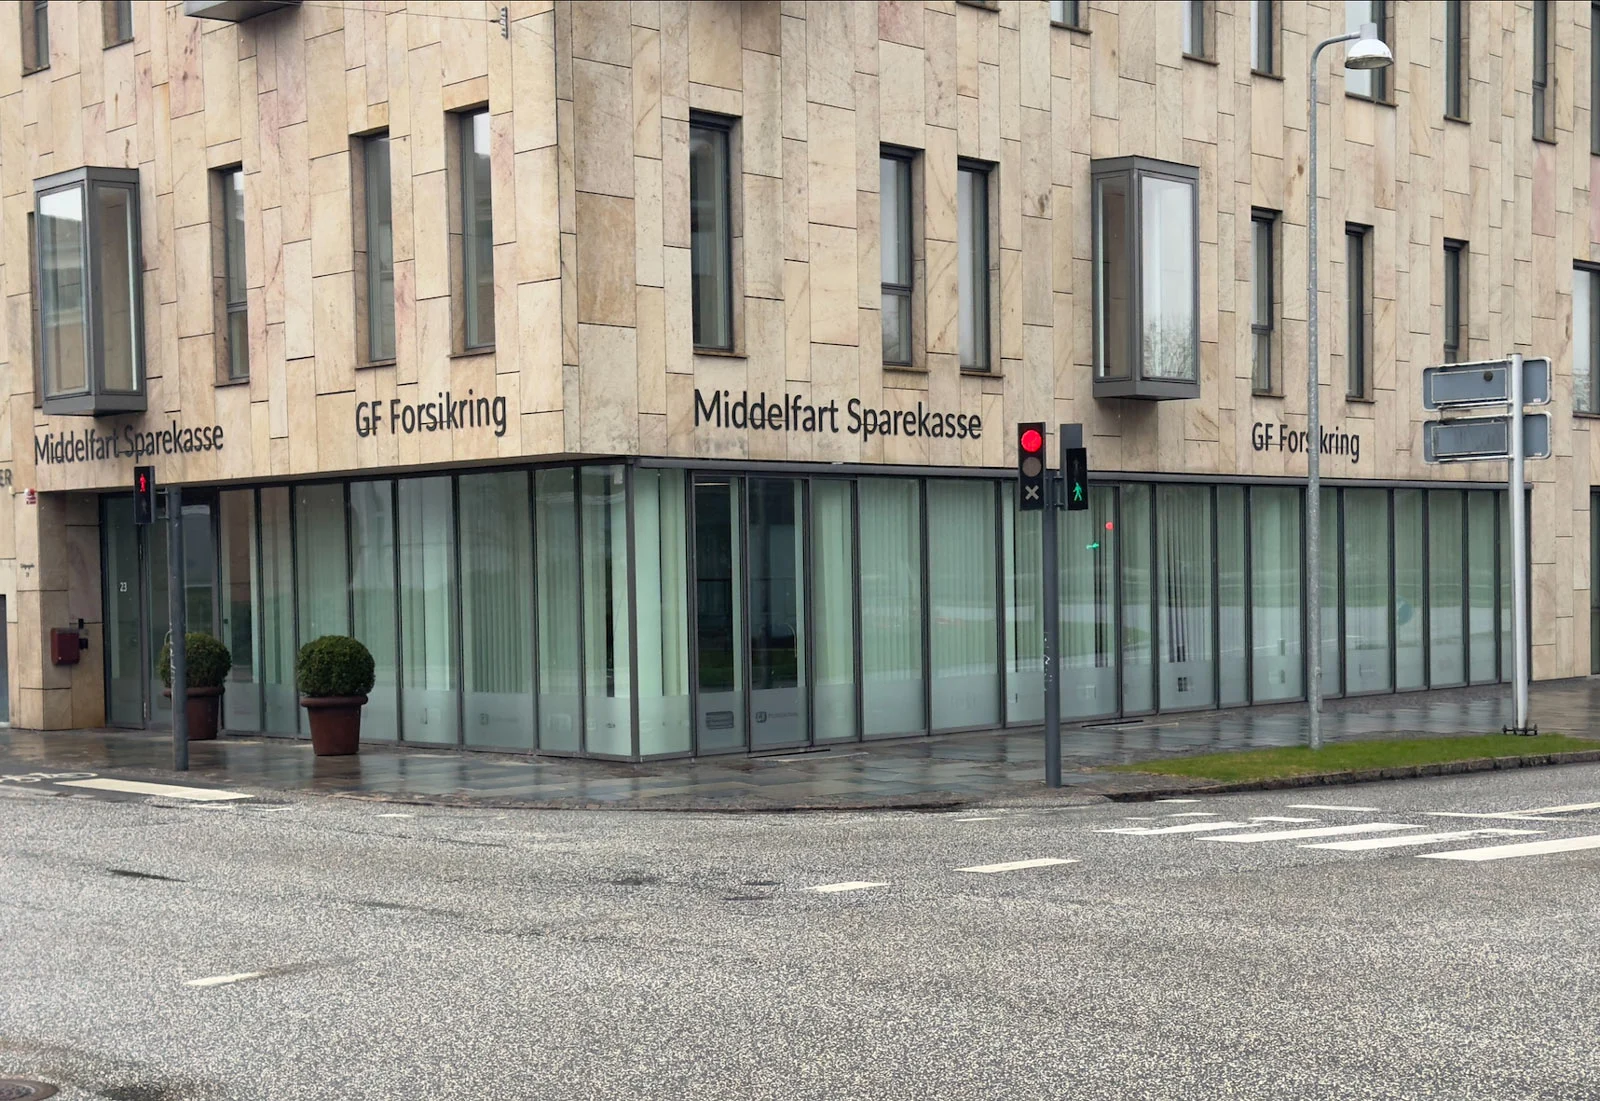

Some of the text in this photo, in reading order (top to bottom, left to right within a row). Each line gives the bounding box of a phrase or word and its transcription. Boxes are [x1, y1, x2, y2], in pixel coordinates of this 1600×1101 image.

[356, 388, 506, 437] GF Forsikring
[694, 388, 982, 442] Middelfart Sparekasse
[35, 420, 223, 465] Middelfart Sparekasse
[1252, 422, 1360, 464] GF Forkring
[120, 581, 127, 592] 23
